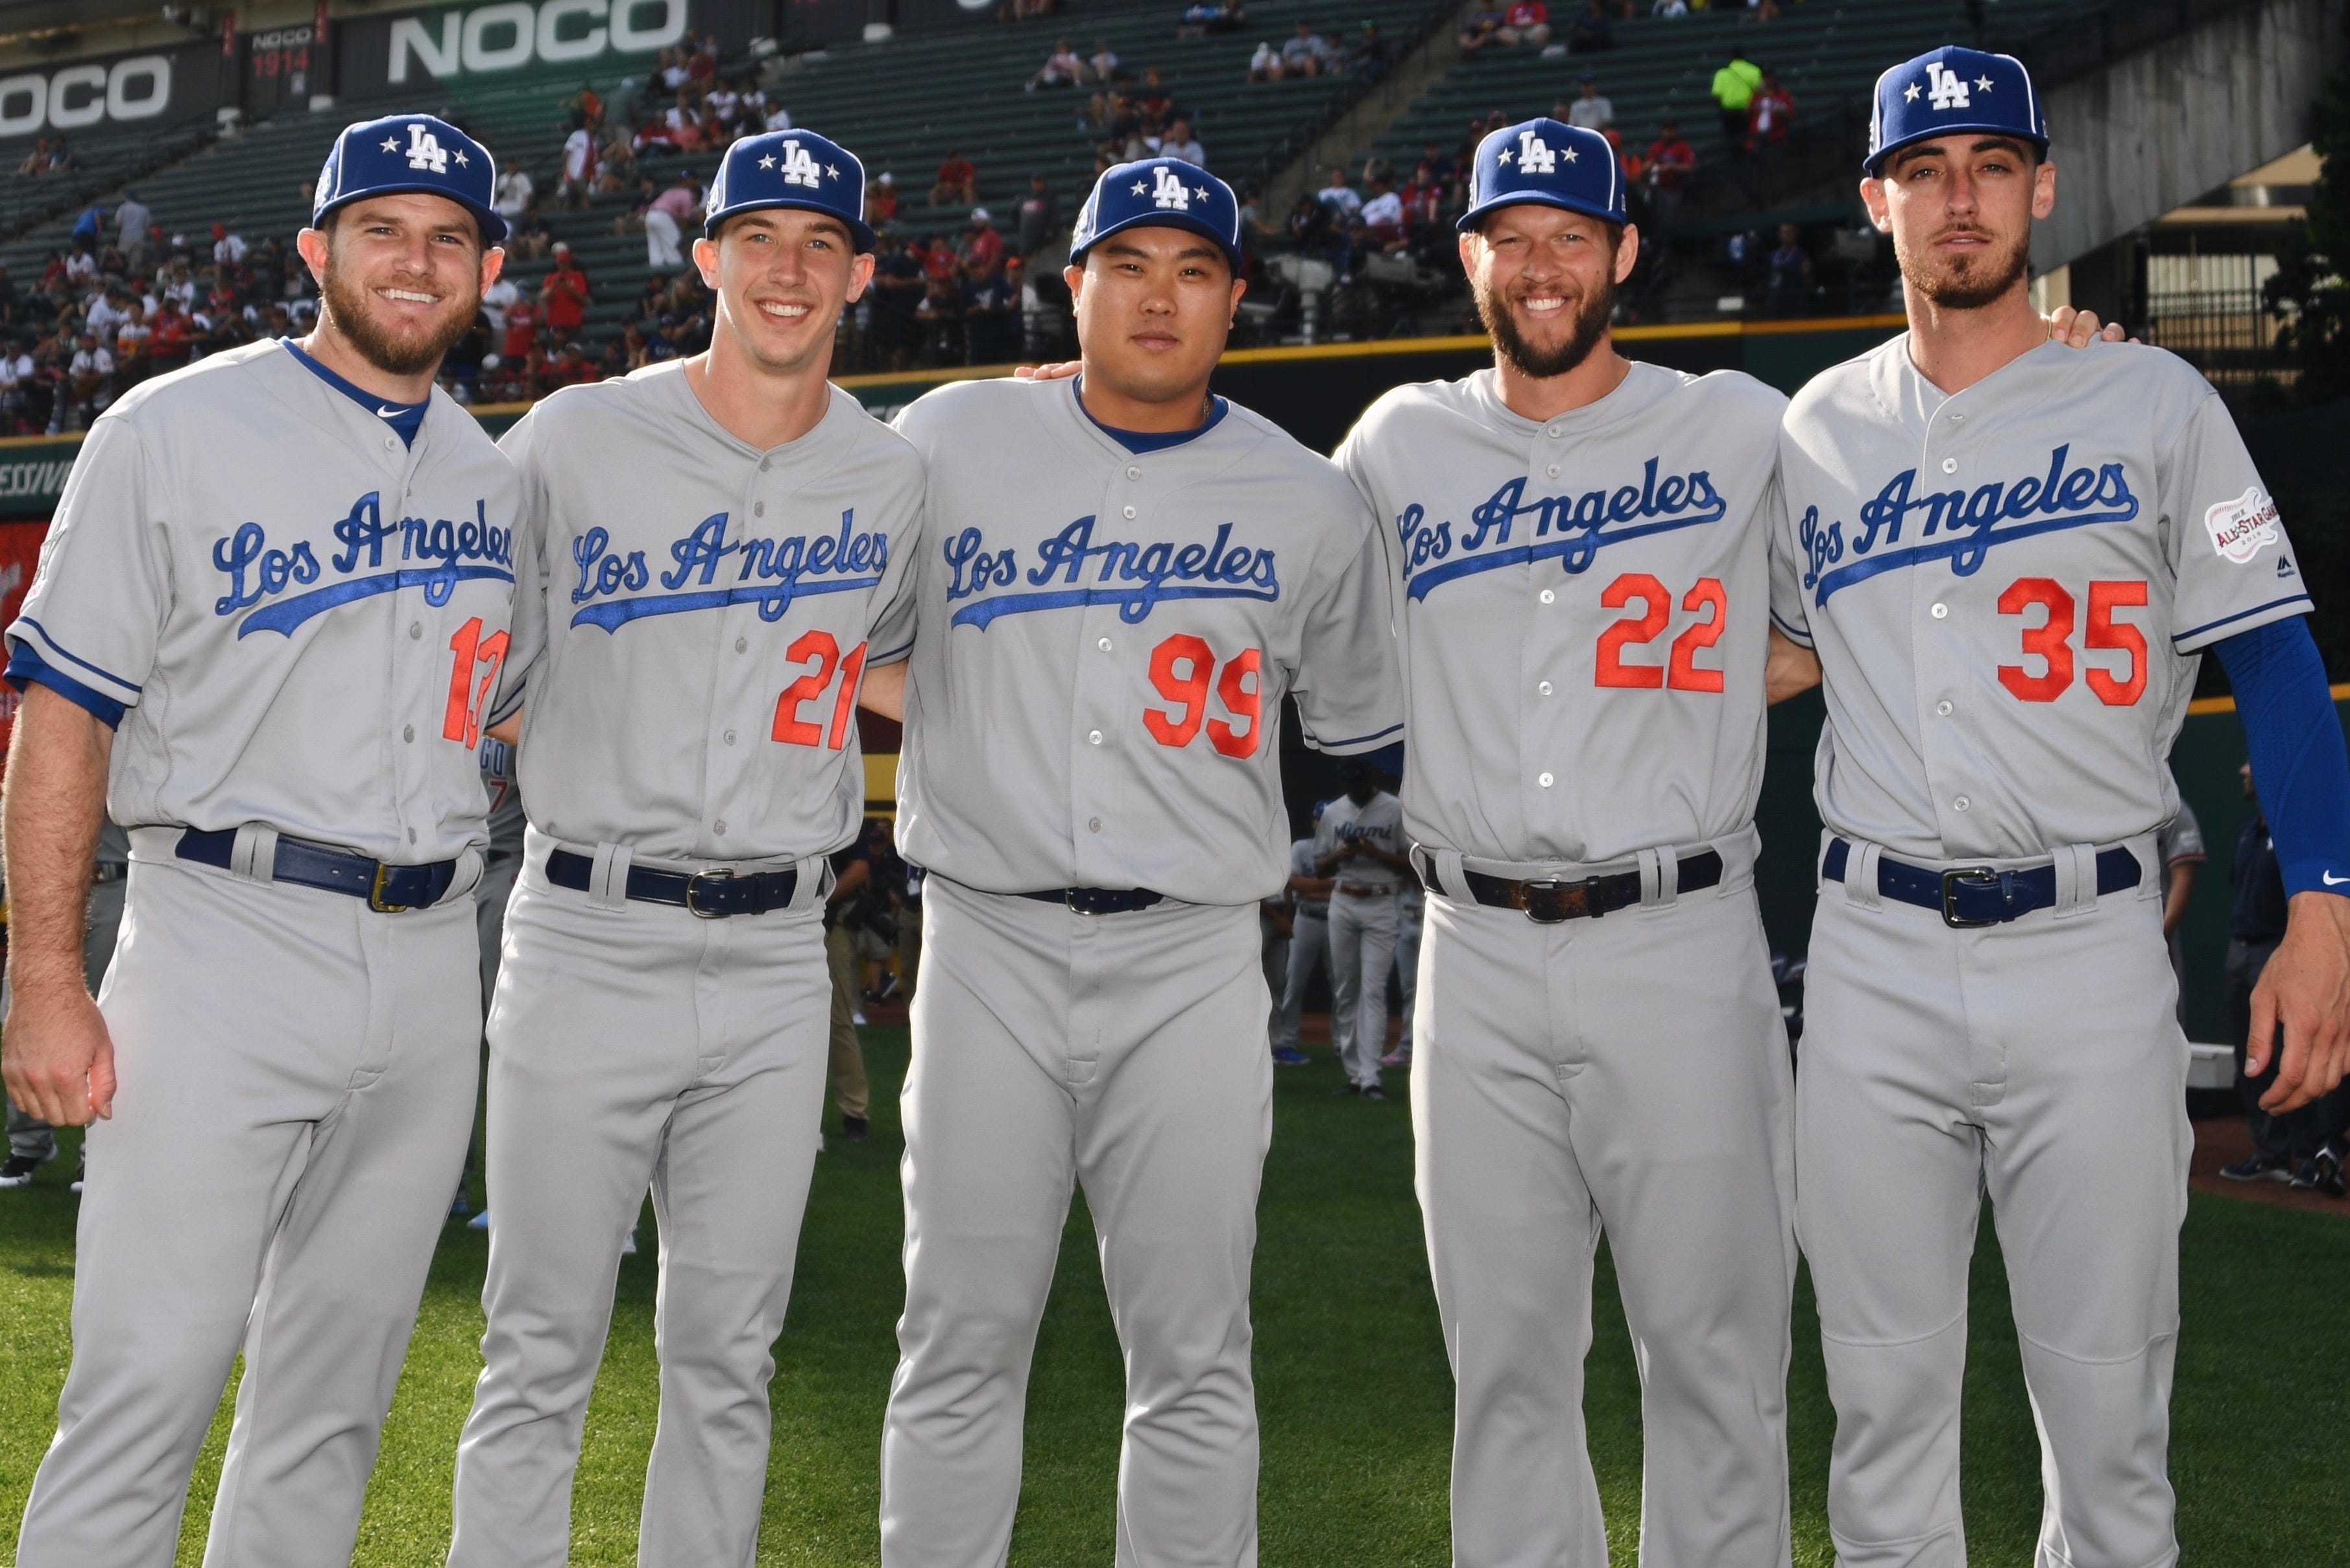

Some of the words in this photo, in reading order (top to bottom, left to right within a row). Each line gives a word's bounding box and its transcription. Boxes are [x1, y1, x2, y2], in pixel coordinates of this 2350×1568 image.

[252, 27, 311, 50] NOCO
[389, 0, 686, 82] NOCO
[1926, 62, 1970, 110] LA
[405, 123, 447, 174] LA
[781, 139, 820, 189] LA
[1152, 166, 1188, 210] LA
[1518, 130, 1555, 174] LA
[1397, 503, 1452, 580] Los
[1461, 456, 1726, 574] Angeles
[1800, 504, 1842, 590] Los
[1853, 443, 2139, 576] Angeles
[213, 522, 320, 616] Los
[571, 527, 649, 604] Los
[660, 508, 887, 623] Angeles
[944, 527, 1017, 602] Los
[1027, 515, 1279, 624] Angeles
[1594, 573, 1727, 693] 22
[1997, 576, 2148, 706] 35
[771, 629, 868, 751] 21
[1142, 633, 1260, 759] 99
[1334, 821, 1393, 841] Miami
